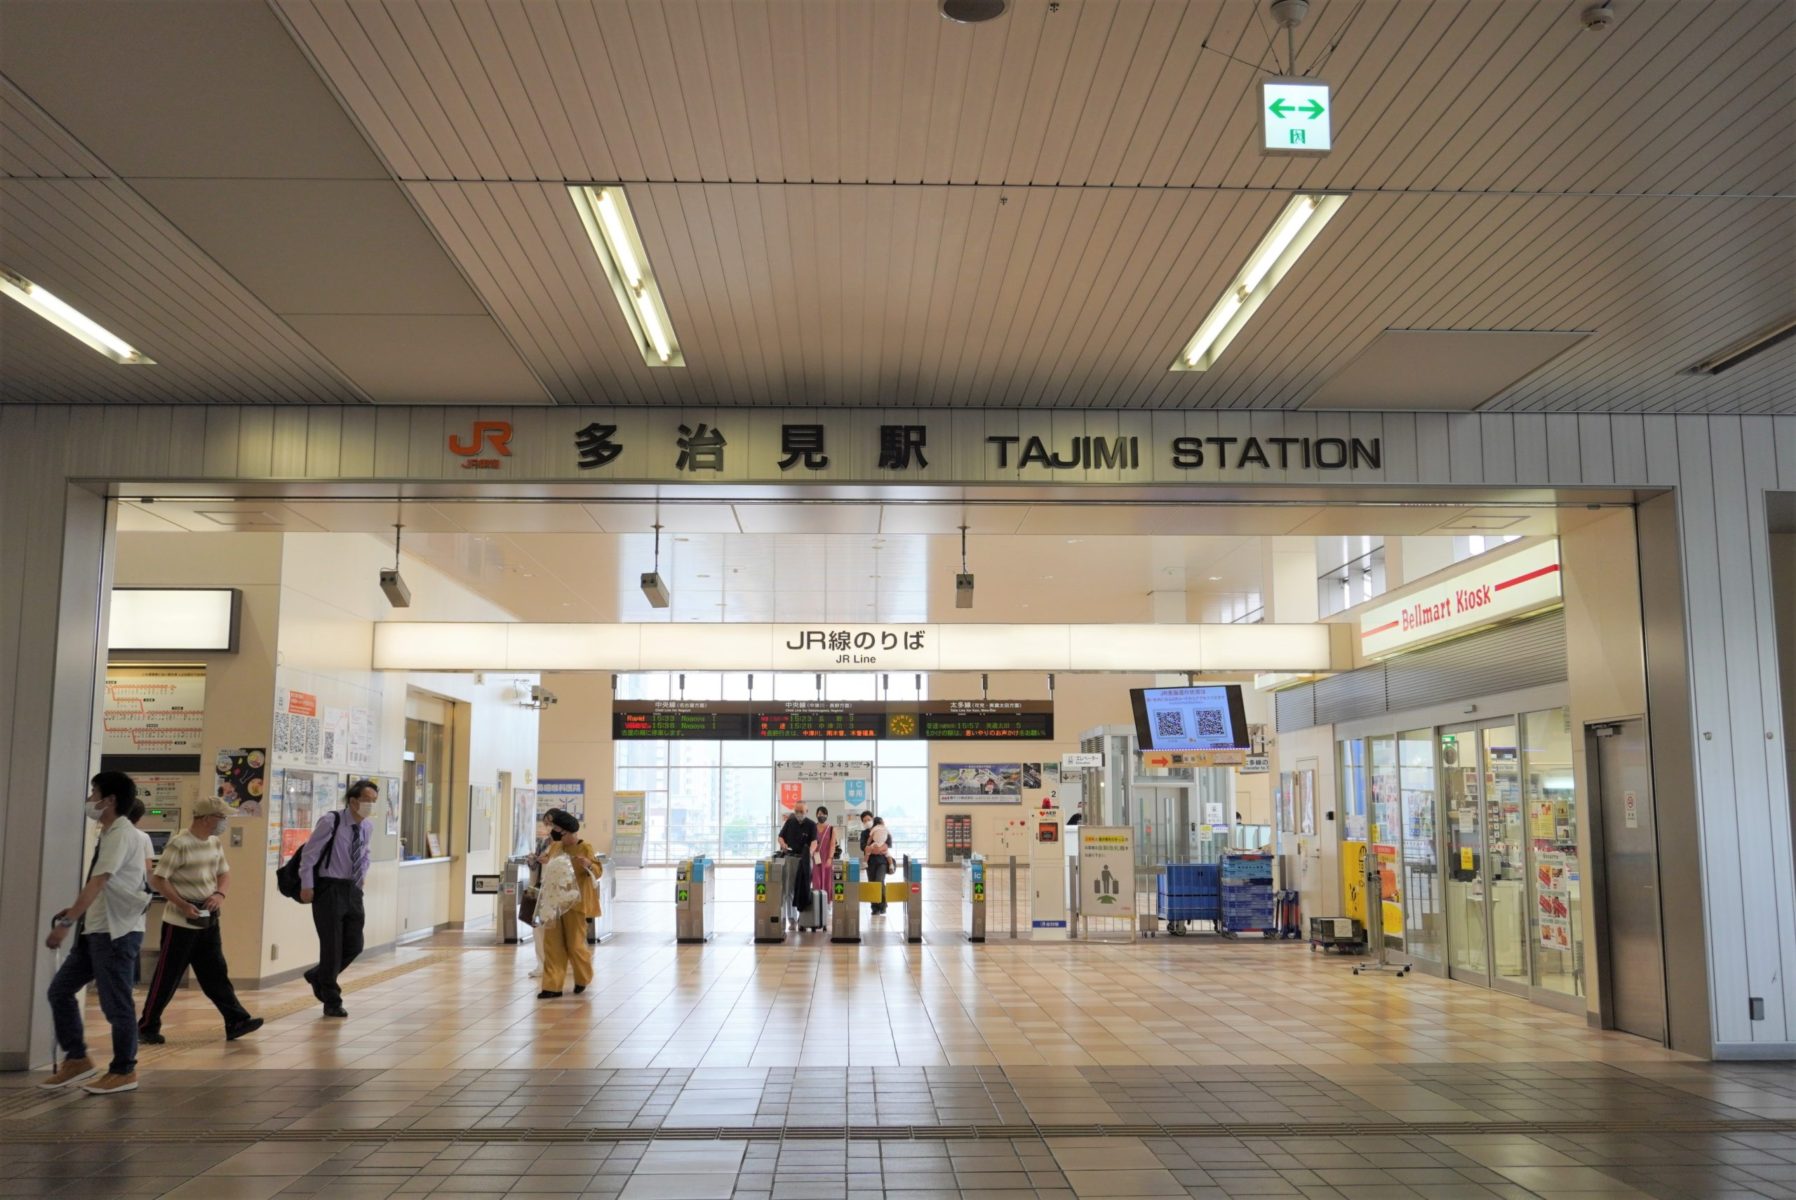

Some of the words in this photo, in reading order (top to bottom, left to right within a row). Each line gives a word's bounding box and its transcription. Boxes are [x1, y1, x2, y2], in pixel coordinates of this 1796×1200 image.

[449, 422, 513, 457] JR
[575, 422, 929, 472] 多治見駅
[987, 435, 1139, 470] TAJIMI
[1171, 436, 1383, 470] STATION
[1401, 597, 1451, 631] Bellmart
[1456, 584, 1491, 613] Kiosk
[786, 630, 926, 651] JR線のりば
[836, 655, 850, 664] JR
[853, 655, 877, 664] Line
[681, 715, 706, 723] Nagoya
[1051, 790, 1057, 798] 2
